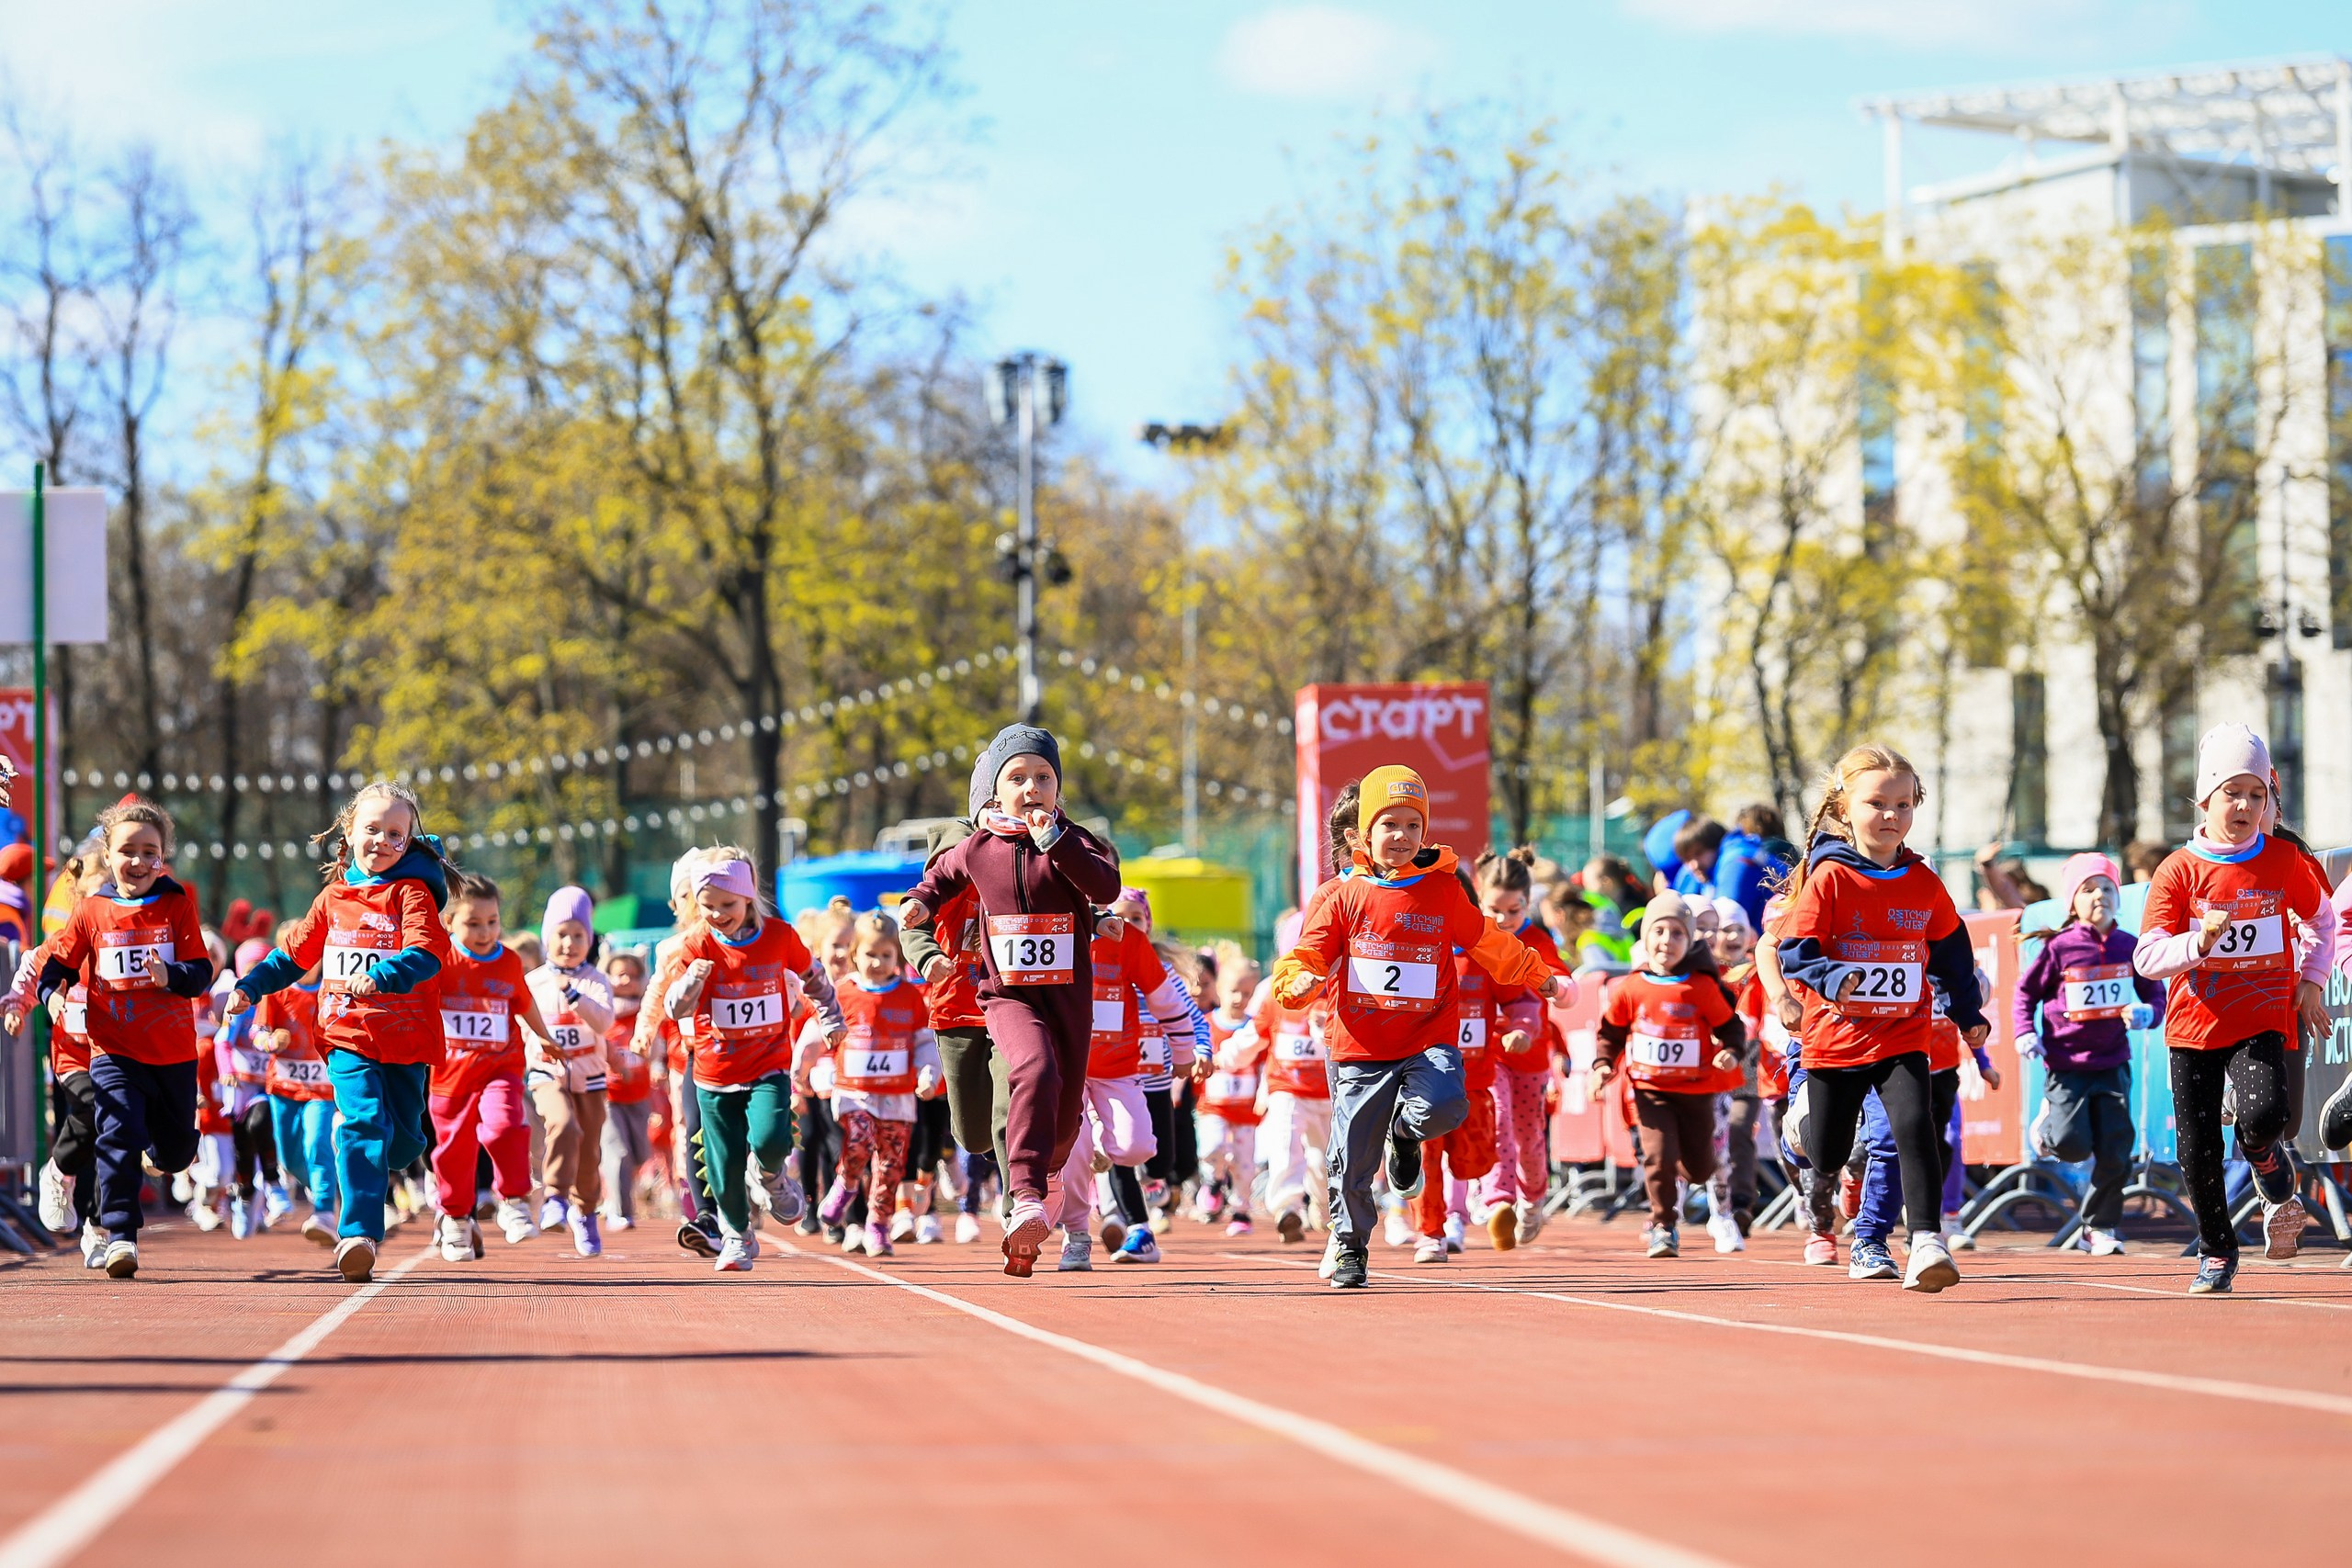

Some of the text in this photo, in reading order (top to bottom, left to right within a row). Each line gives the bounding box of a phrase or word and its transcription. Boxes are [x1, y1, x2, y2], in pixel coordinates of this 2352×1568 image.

[2260, 906, 2275, 916] 4-5
[1051, 924, 1068, 932] 4-5
[2220, 924, 2257, 953] 39
[376, 940, 393, 948] 4-5
[1004, 939, 1055, 965] 138
[1416, 953, 1431, 962] 4-5
[1902, 952, 1916, 961] 4-5
[1384, 965, 1401, 992] 2
[1849, 967, 1906, 998] 228
[2083, 983, 2120, 1005] 219
[727, 1000, 765, 1024] 191
[453, 1014, 492, 1036] 112
[1294, 1040, 1315, 1055] 84
[2324, 1017, 2352, 1065] ИСТ
[1648, 1042, 1683, 1063] 109
[288, 1063, 322, 1081] 232
[866, 1055, 890, 1072] 44
